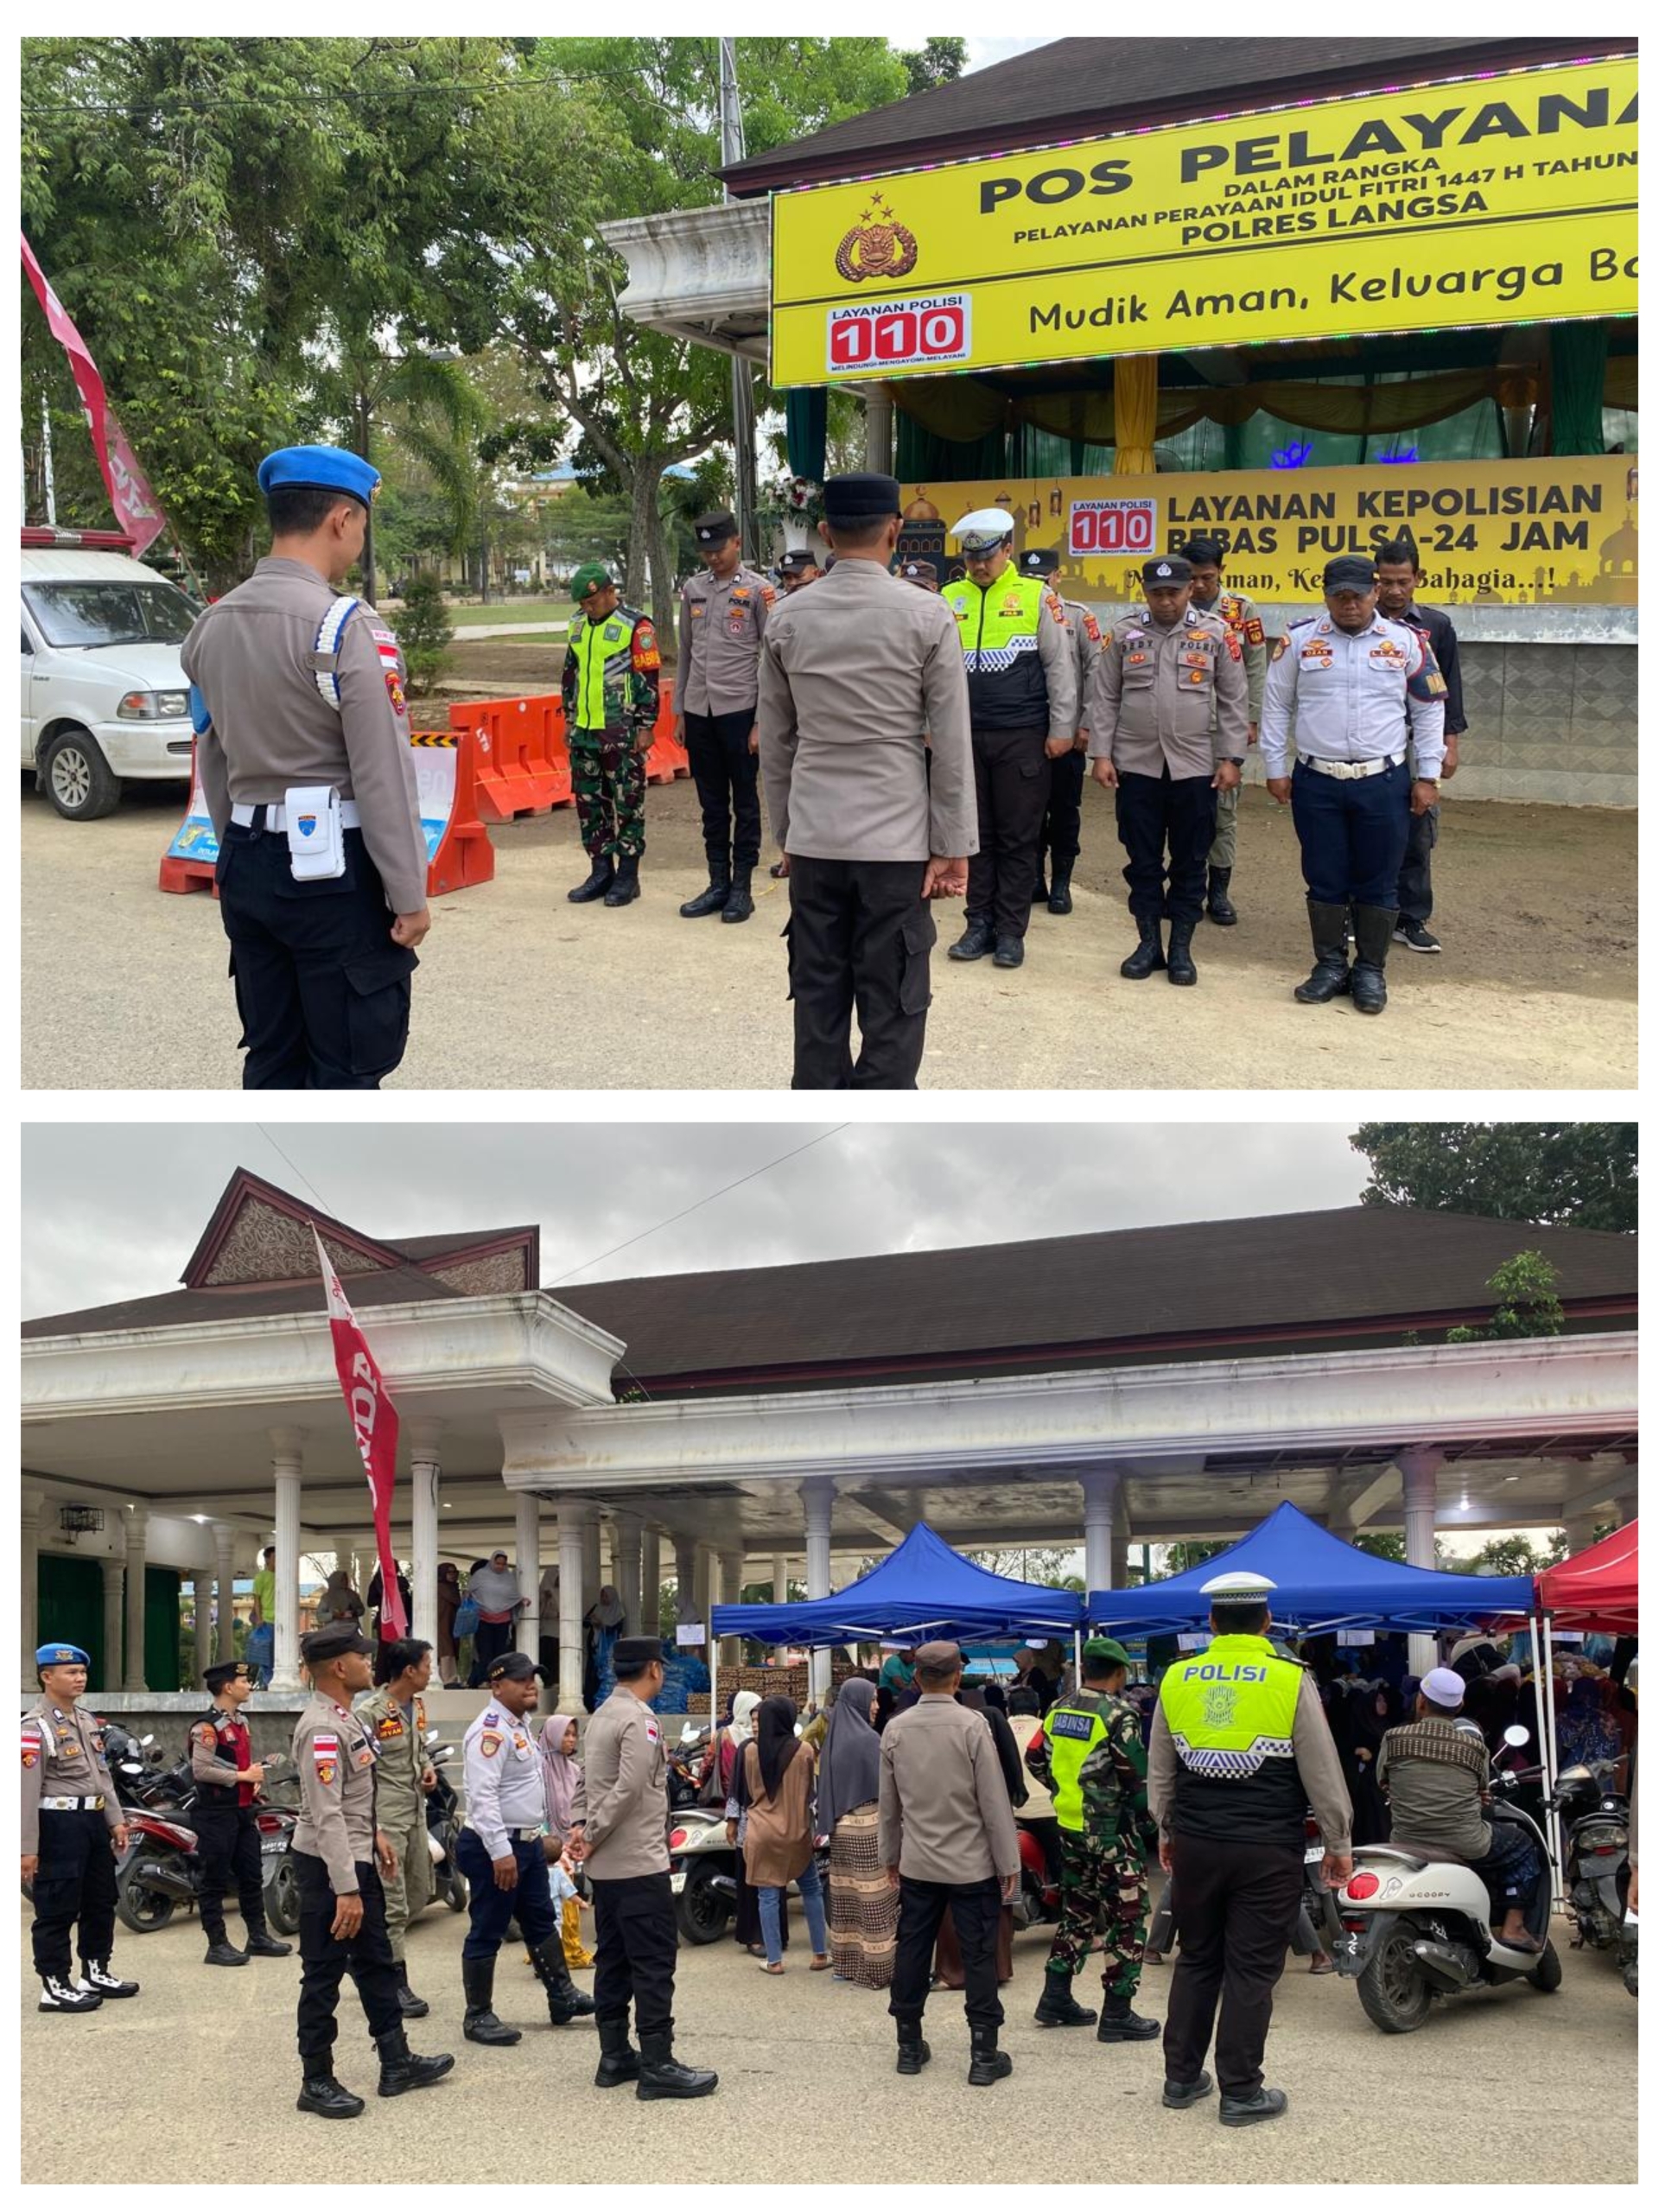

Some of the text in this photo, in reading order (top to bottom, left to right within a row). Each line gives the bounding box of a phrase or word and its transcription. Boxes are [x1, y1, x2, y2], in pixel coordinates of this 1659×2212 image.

[979, 159, 1134, 214] POS
[1224, 156, 1441, 198] DALAM RANGKA
[1013, 150, 1638, 245] PELAYANAN PERAYAAN IDUL FITRI 1447 H TAHUN
[1181, 190, 1489, 246] POLRES LANGSA
[832, 296, 963, 320] LAYANAN POLISI
[1029, 294, 1149, 334] Mudik
[1165, 286, 1309, 320] Aman,
[1329, 259, 1565, 305] Keluarga
[836, 315, 957, 357] 110
[1073, 499, 1152, 511] LAYANAN POLISI
[1168, 484, 1602, 522] LAYANAN KEPOLISIAN
[1075, 514, 1148, 545] 110
[1298, 523, 1478, 553] PULSA-24
[1499, 520, 1589, 551] JAM
[1217, 571, 1281, 593] man,
[1183, 1663, 1268, 1683] POLISI
